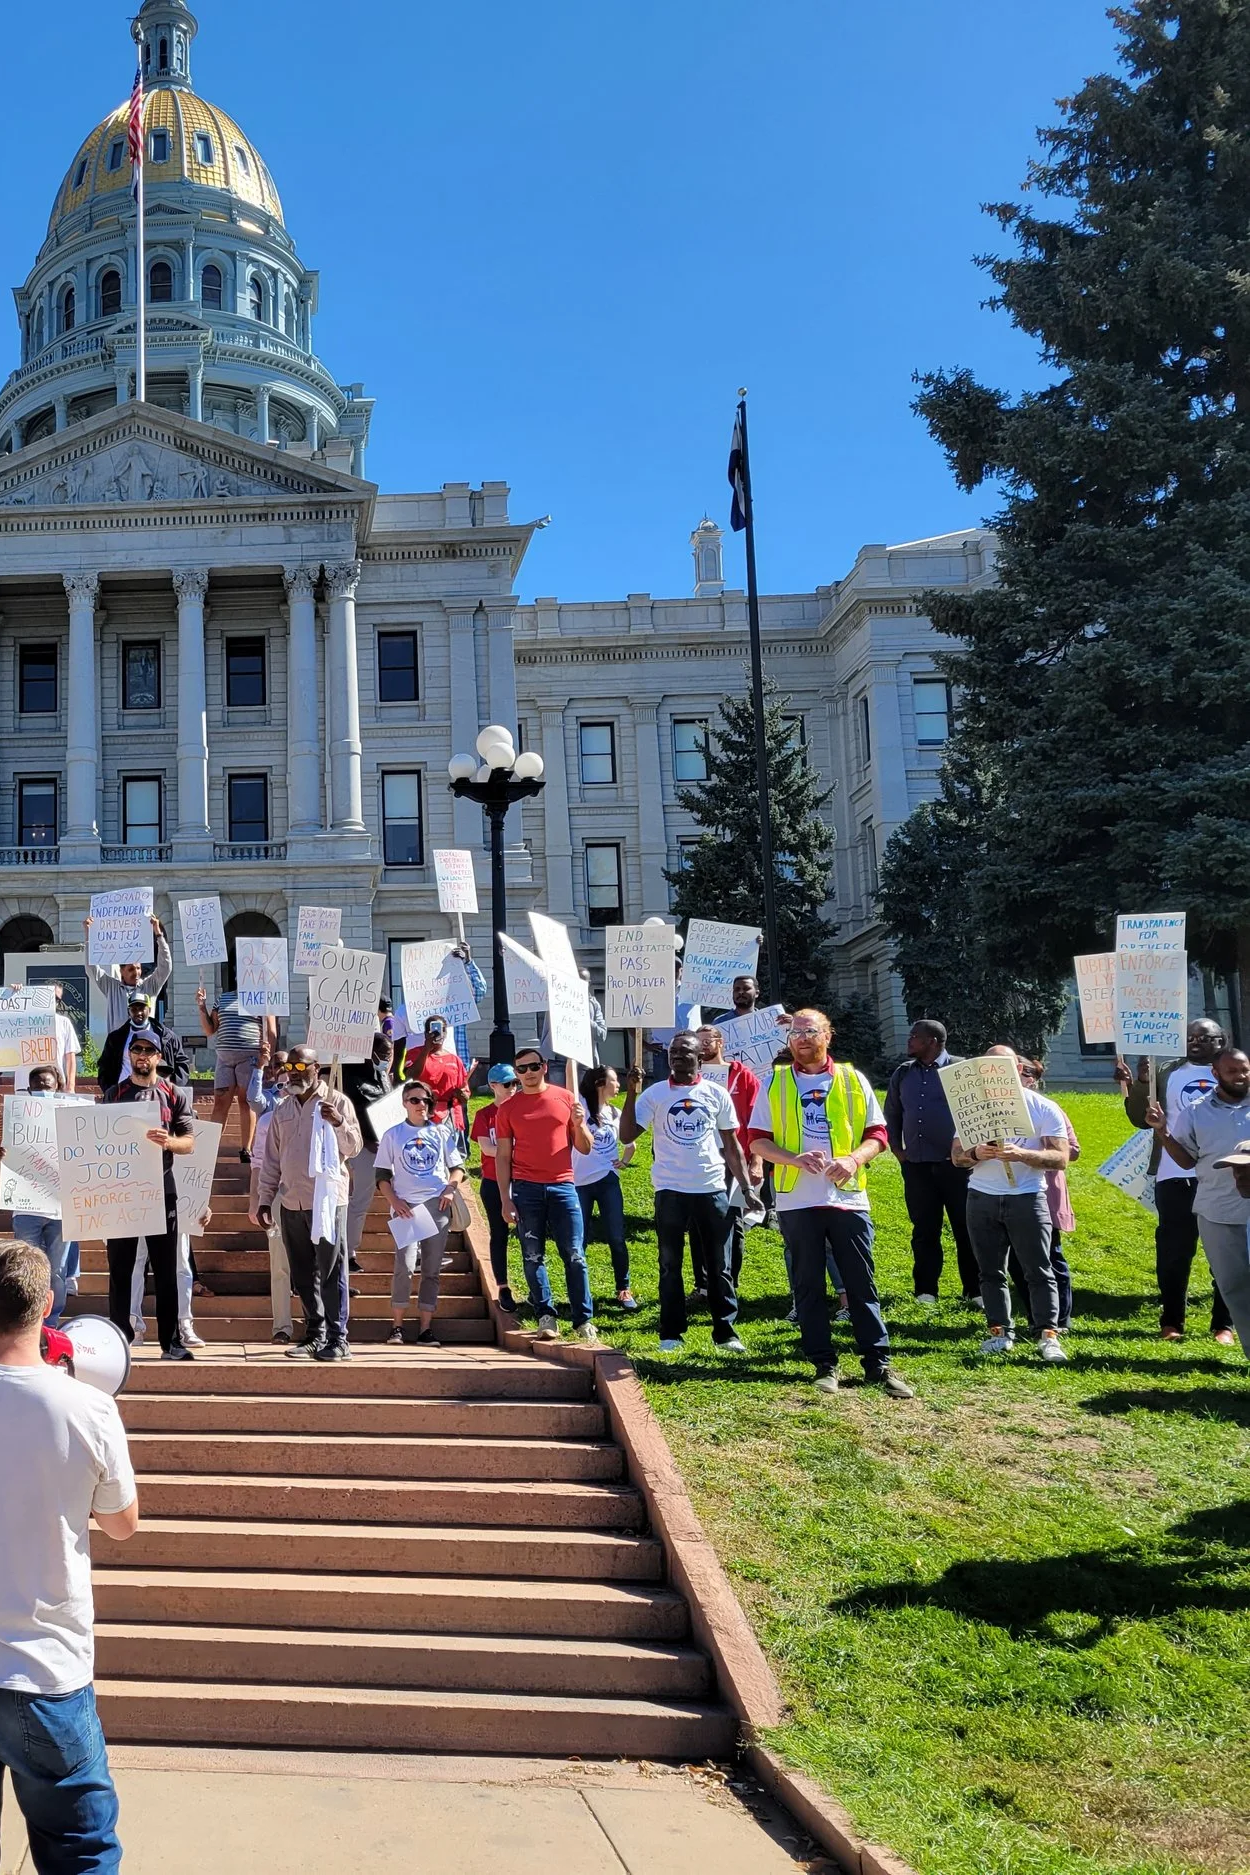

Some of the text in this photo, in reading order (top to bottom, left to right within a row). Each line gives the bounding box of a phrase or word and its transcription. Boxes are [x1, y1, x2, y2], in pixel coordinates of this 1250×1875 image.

[92, 892, 149, 907] COLORADO
[442, 899, 473, 909] UNITY
[91, 905, 150, 917] INDEPENDENT
[184, 902, 215, 916] UBER
[320, 910, 337, 918] MAX
[100, 919, 142, 929] DRIVERS
[187, 919, 214, 930] LYFT
[300, 919, 337, 929] TAKE RATE
[691, 922, 744, 937] CORPORATE
[1120, 919, 1184, 930] TRANSPARENCY
[97, 930, 140, 941] UNITED
[186, 932, 218, 944] STEAL
[299, 931, 314, 940] FARE
[617, 930, 643, 942] END
[689, 933, 716, 943] GREED
[1139, 931, 1158, 940] FOR
[197, 941, 213, 949] OUR
[699, 943, 741, 957] DISEASE
[241, 943, 284, 966] 25%
[322, 951, 370, 975] OUR
[620, 957, 651, 970] PASS
[686, 954, 753, 970] ORGANIZATION
[1120, 953, 1179, 971] ENFORCE
[242, 968, 279, 986] MAX
[405, 975, 462, 990] FAIR PRICES
[515, 979, 531, 988] PAY
[702, 974, 733, 984] REMED
[1134, 973, 1154, 984] THE
[318, 977, 377, 1004] CARS
[685, 982, 713, 991] JOIN
[1120, 986, 1166, 996] TNC ACT
[239, 991, 288, 1007] TAKE RATE
[409, 995, 456, 1009] PASSENGERS
[691, 992, 732, 1004] UNION
[1134, 998, 1168, 1010] 2014
[312, 1003, 339, 1022] OUR
[416, 1002, 471, 1018] SOLIDARITY
[1158, 1012, 1184, 1020] YEARS
[8, 1018, 24, 1027] WE
[325, 1022, 347, 1033] OUR
[1123, 1019, 1169, 1029] ENOUGH
[26, 1028, 48, 1036] THIS
[1124, 1033, 1180, 1048] TIME???
[21, 1037, 57, 1063] BREAD
[954, 1064, 1006, 1080] $2 GAS
[950, 1077, 1016, 1097] SURCHARGE
[958, 1088, 1016, 1107] PER RIDE
[11, 1100, 42, 1118] END
[957, 1101, 1004, 1119] DELIVERY
[960, 1110, 1018, 1129] RIDESHARE
[12, 1122, 54, 1146] BULL
[75, 1115, 133, 1141] PUC
[963, 1119, 1007, 1136] DRIVERS
[969, 1127, 1026, 1144] UNITE
[63, 1141, 140, 1162] DO YOUR
[77, 1161, 131, 1184] JOB
[183, 1166, 213, 1189] TAKE
[73, 1189, 163, 1209] ENFORCE THE
[76, 1213, 111, 1232] TNC
[116, 1207, 152, 1225] ACT
